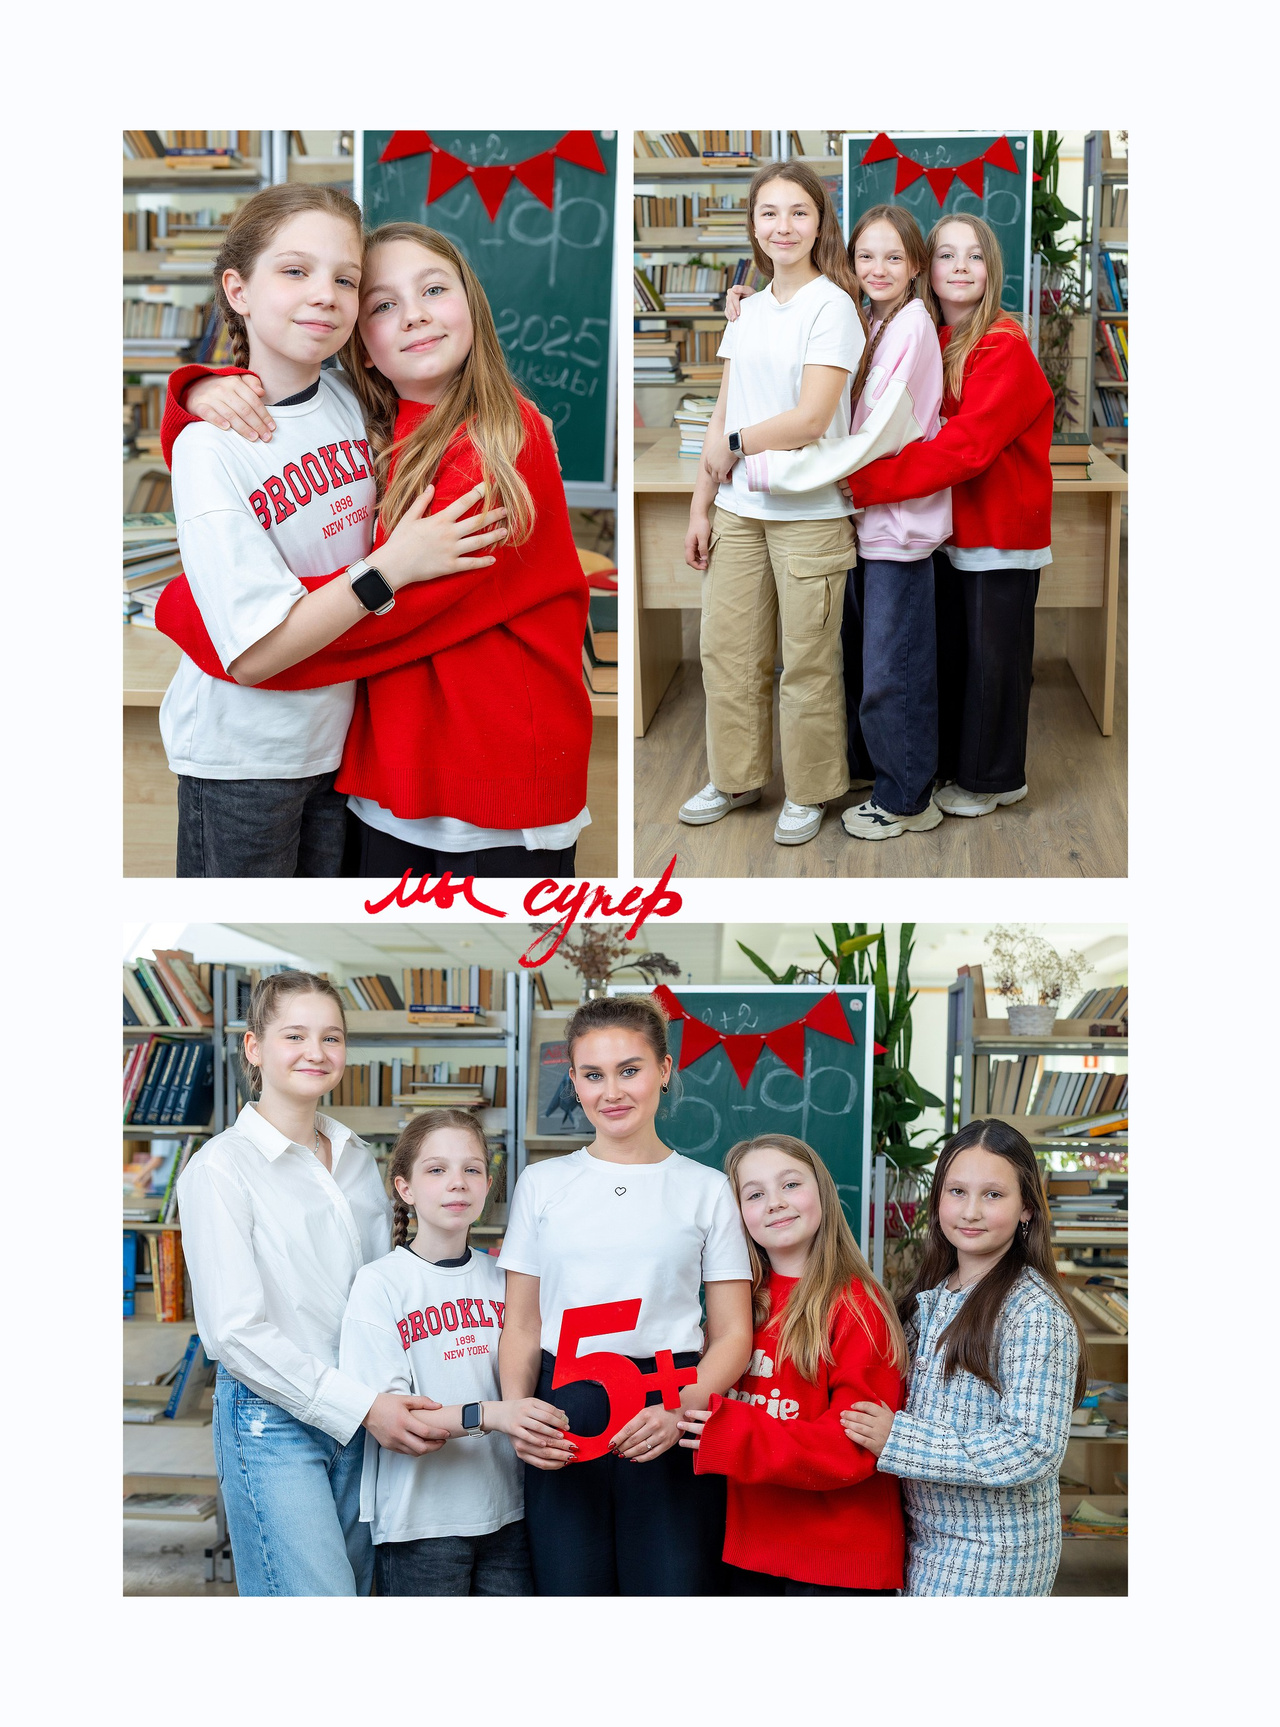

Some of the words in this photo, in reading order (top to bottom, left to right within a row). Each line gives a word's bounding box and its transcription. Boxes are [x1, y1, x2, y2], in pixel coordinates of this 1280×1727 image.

[497, 308, 609, 368] 2025
[329, 495, 354, 516] 1898
[321, 520, 345, 540] NEW
[345, 505, 370, 528] YORK
[443, 1350, 465, 1361] NEW
[466, 1344, 490, 1356] YORK
[455, 1334, 476, 1347] 1898
[552, 1298, 698, 1463] 5+
